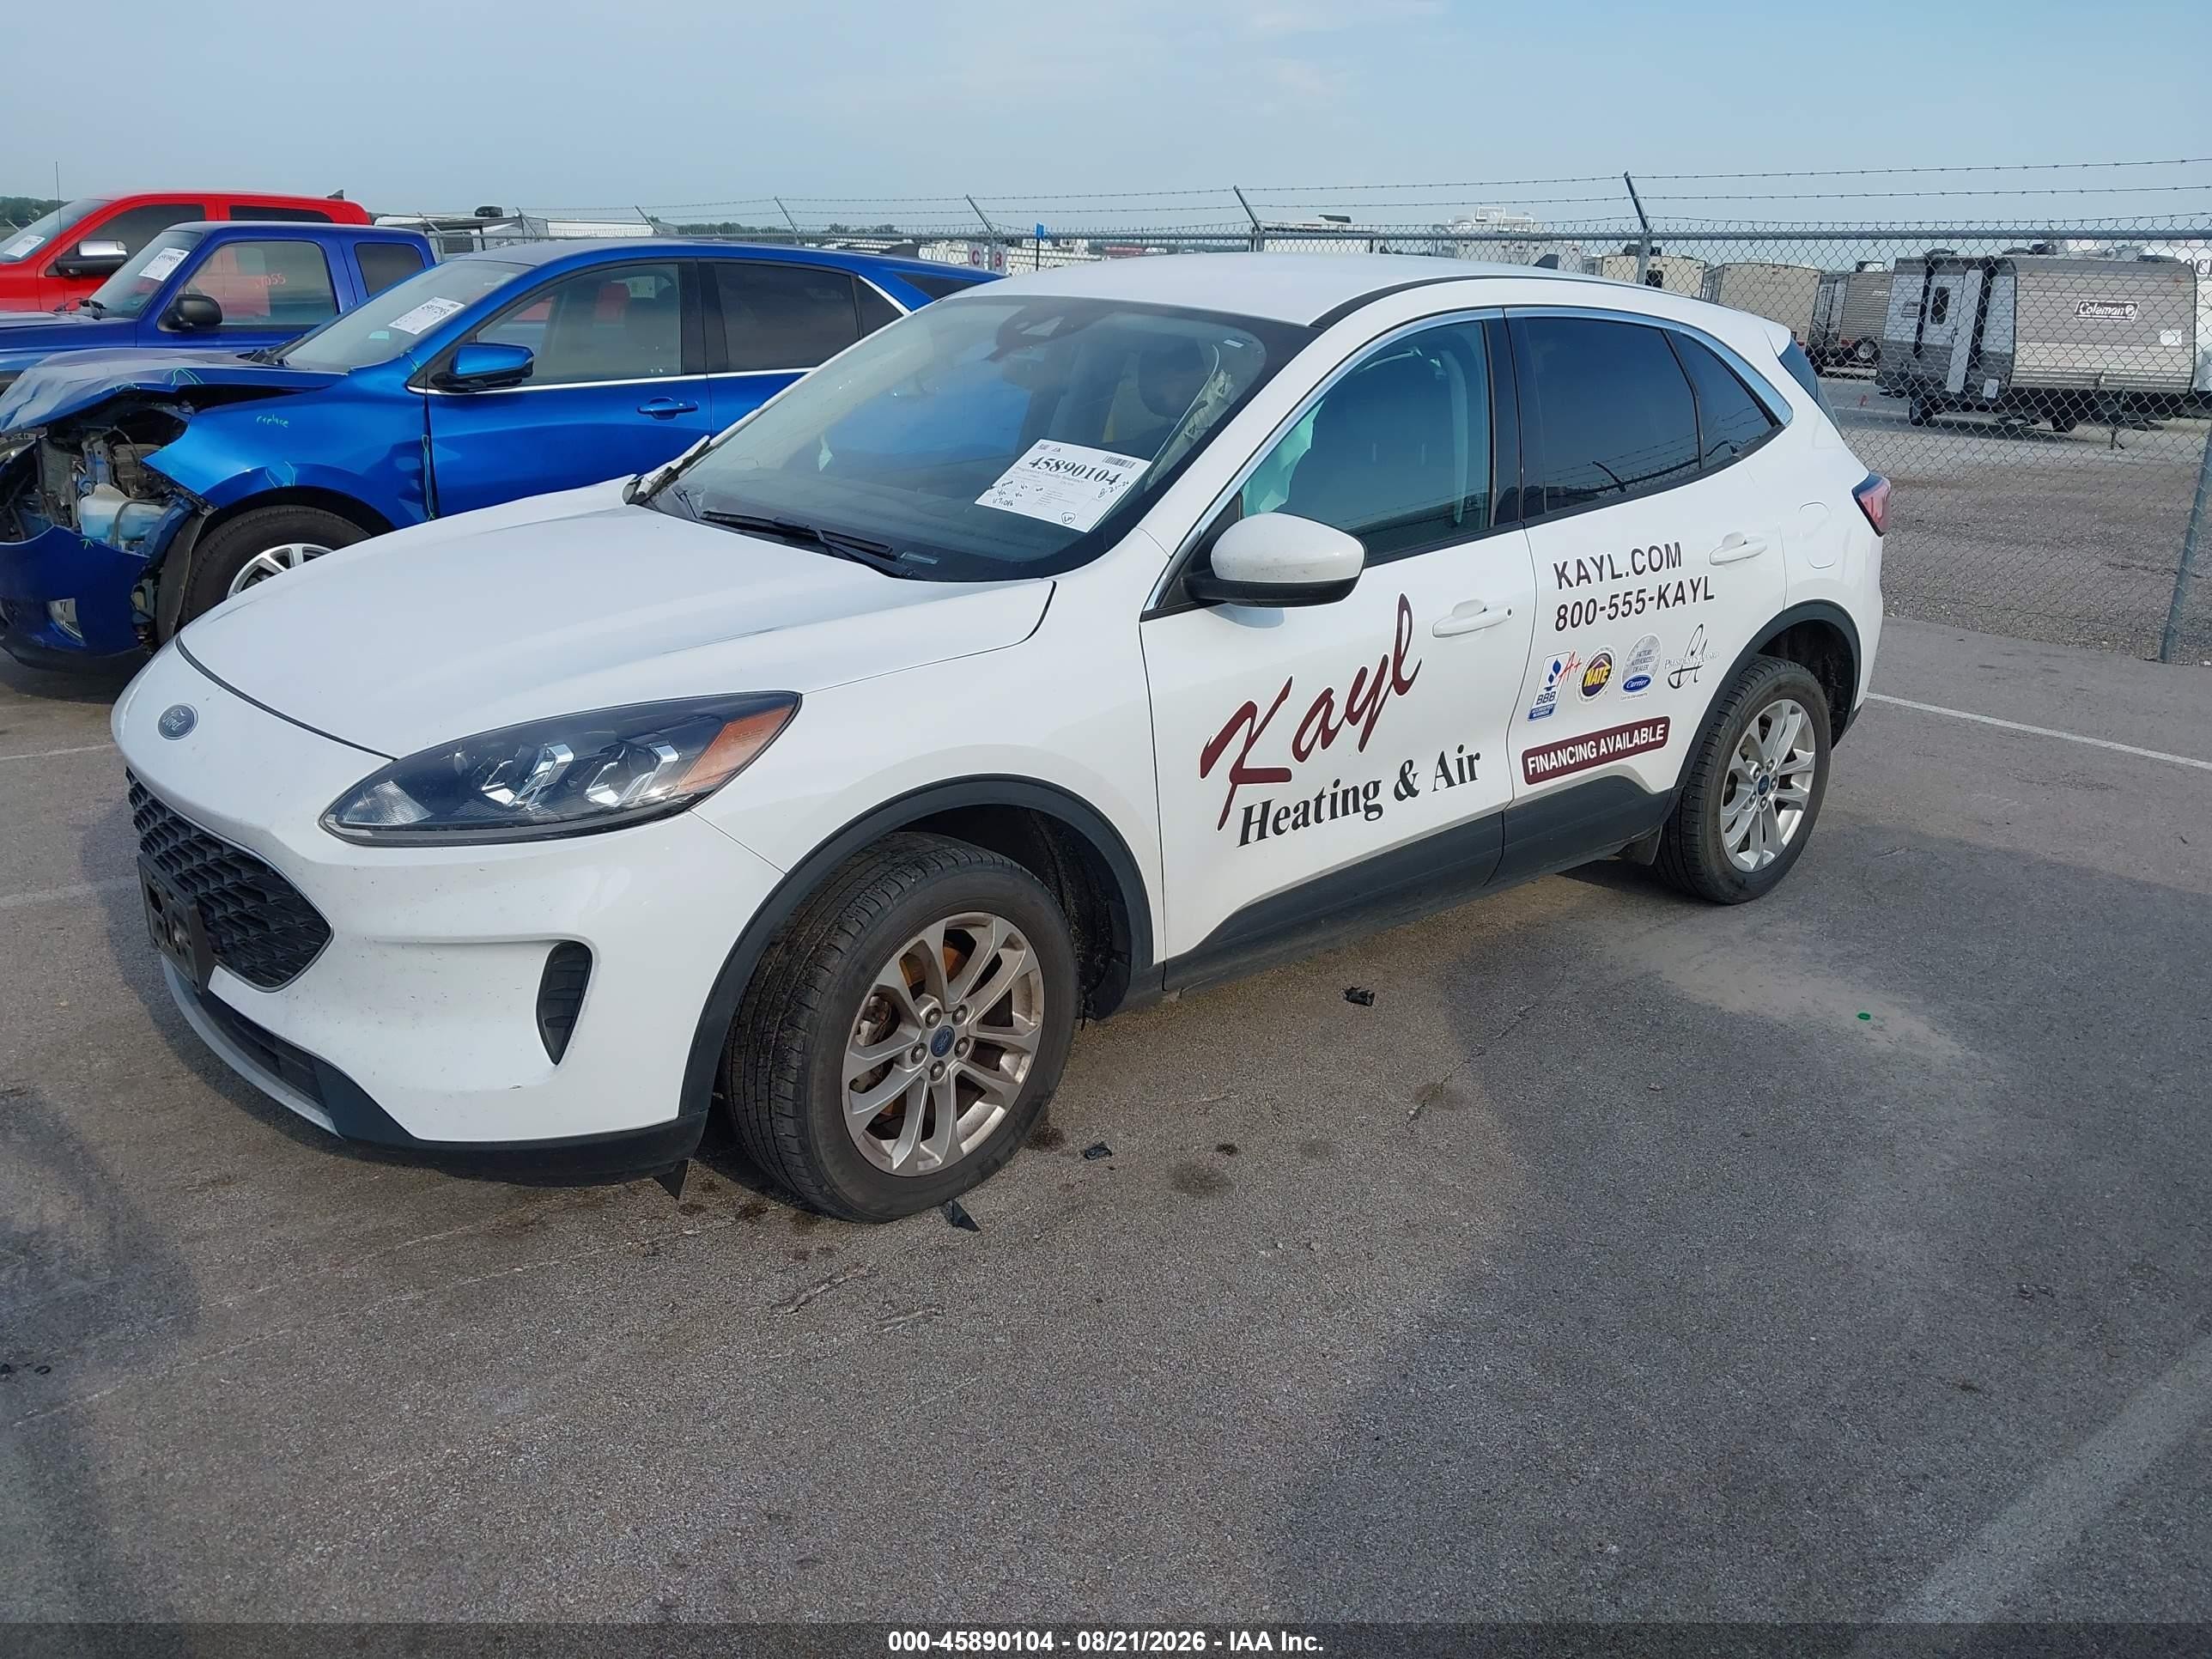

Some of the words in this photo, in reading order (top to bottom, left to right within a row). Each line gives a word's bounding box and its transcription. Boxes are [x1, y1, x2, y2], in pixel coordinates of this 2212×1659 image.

[971, 250, 980, 265] C
[2079, 302, 2125, 316] Coleman
[1029, 456, 1122, 486] 45890104
[1553, 542, 1682, 589] KAYL.COM
[1554, 575, 1715, 631] 800-555-KAYL
[1583, 666, 1609, 687] NATE
[1626, 679, 1648, 688] Carrier
[1200, 592, 1422, 831] Kayl
[1536, 691, 1556, 705] BBB
[1528, 740, 1597, 775] FINANCING
[1599, 724, 1665, 757] AVAILABLE
[1237, 778, 1383, 848] Heating
[1394, 759, 1420, 801] &
[1432, 744, 1480, 792] Air
